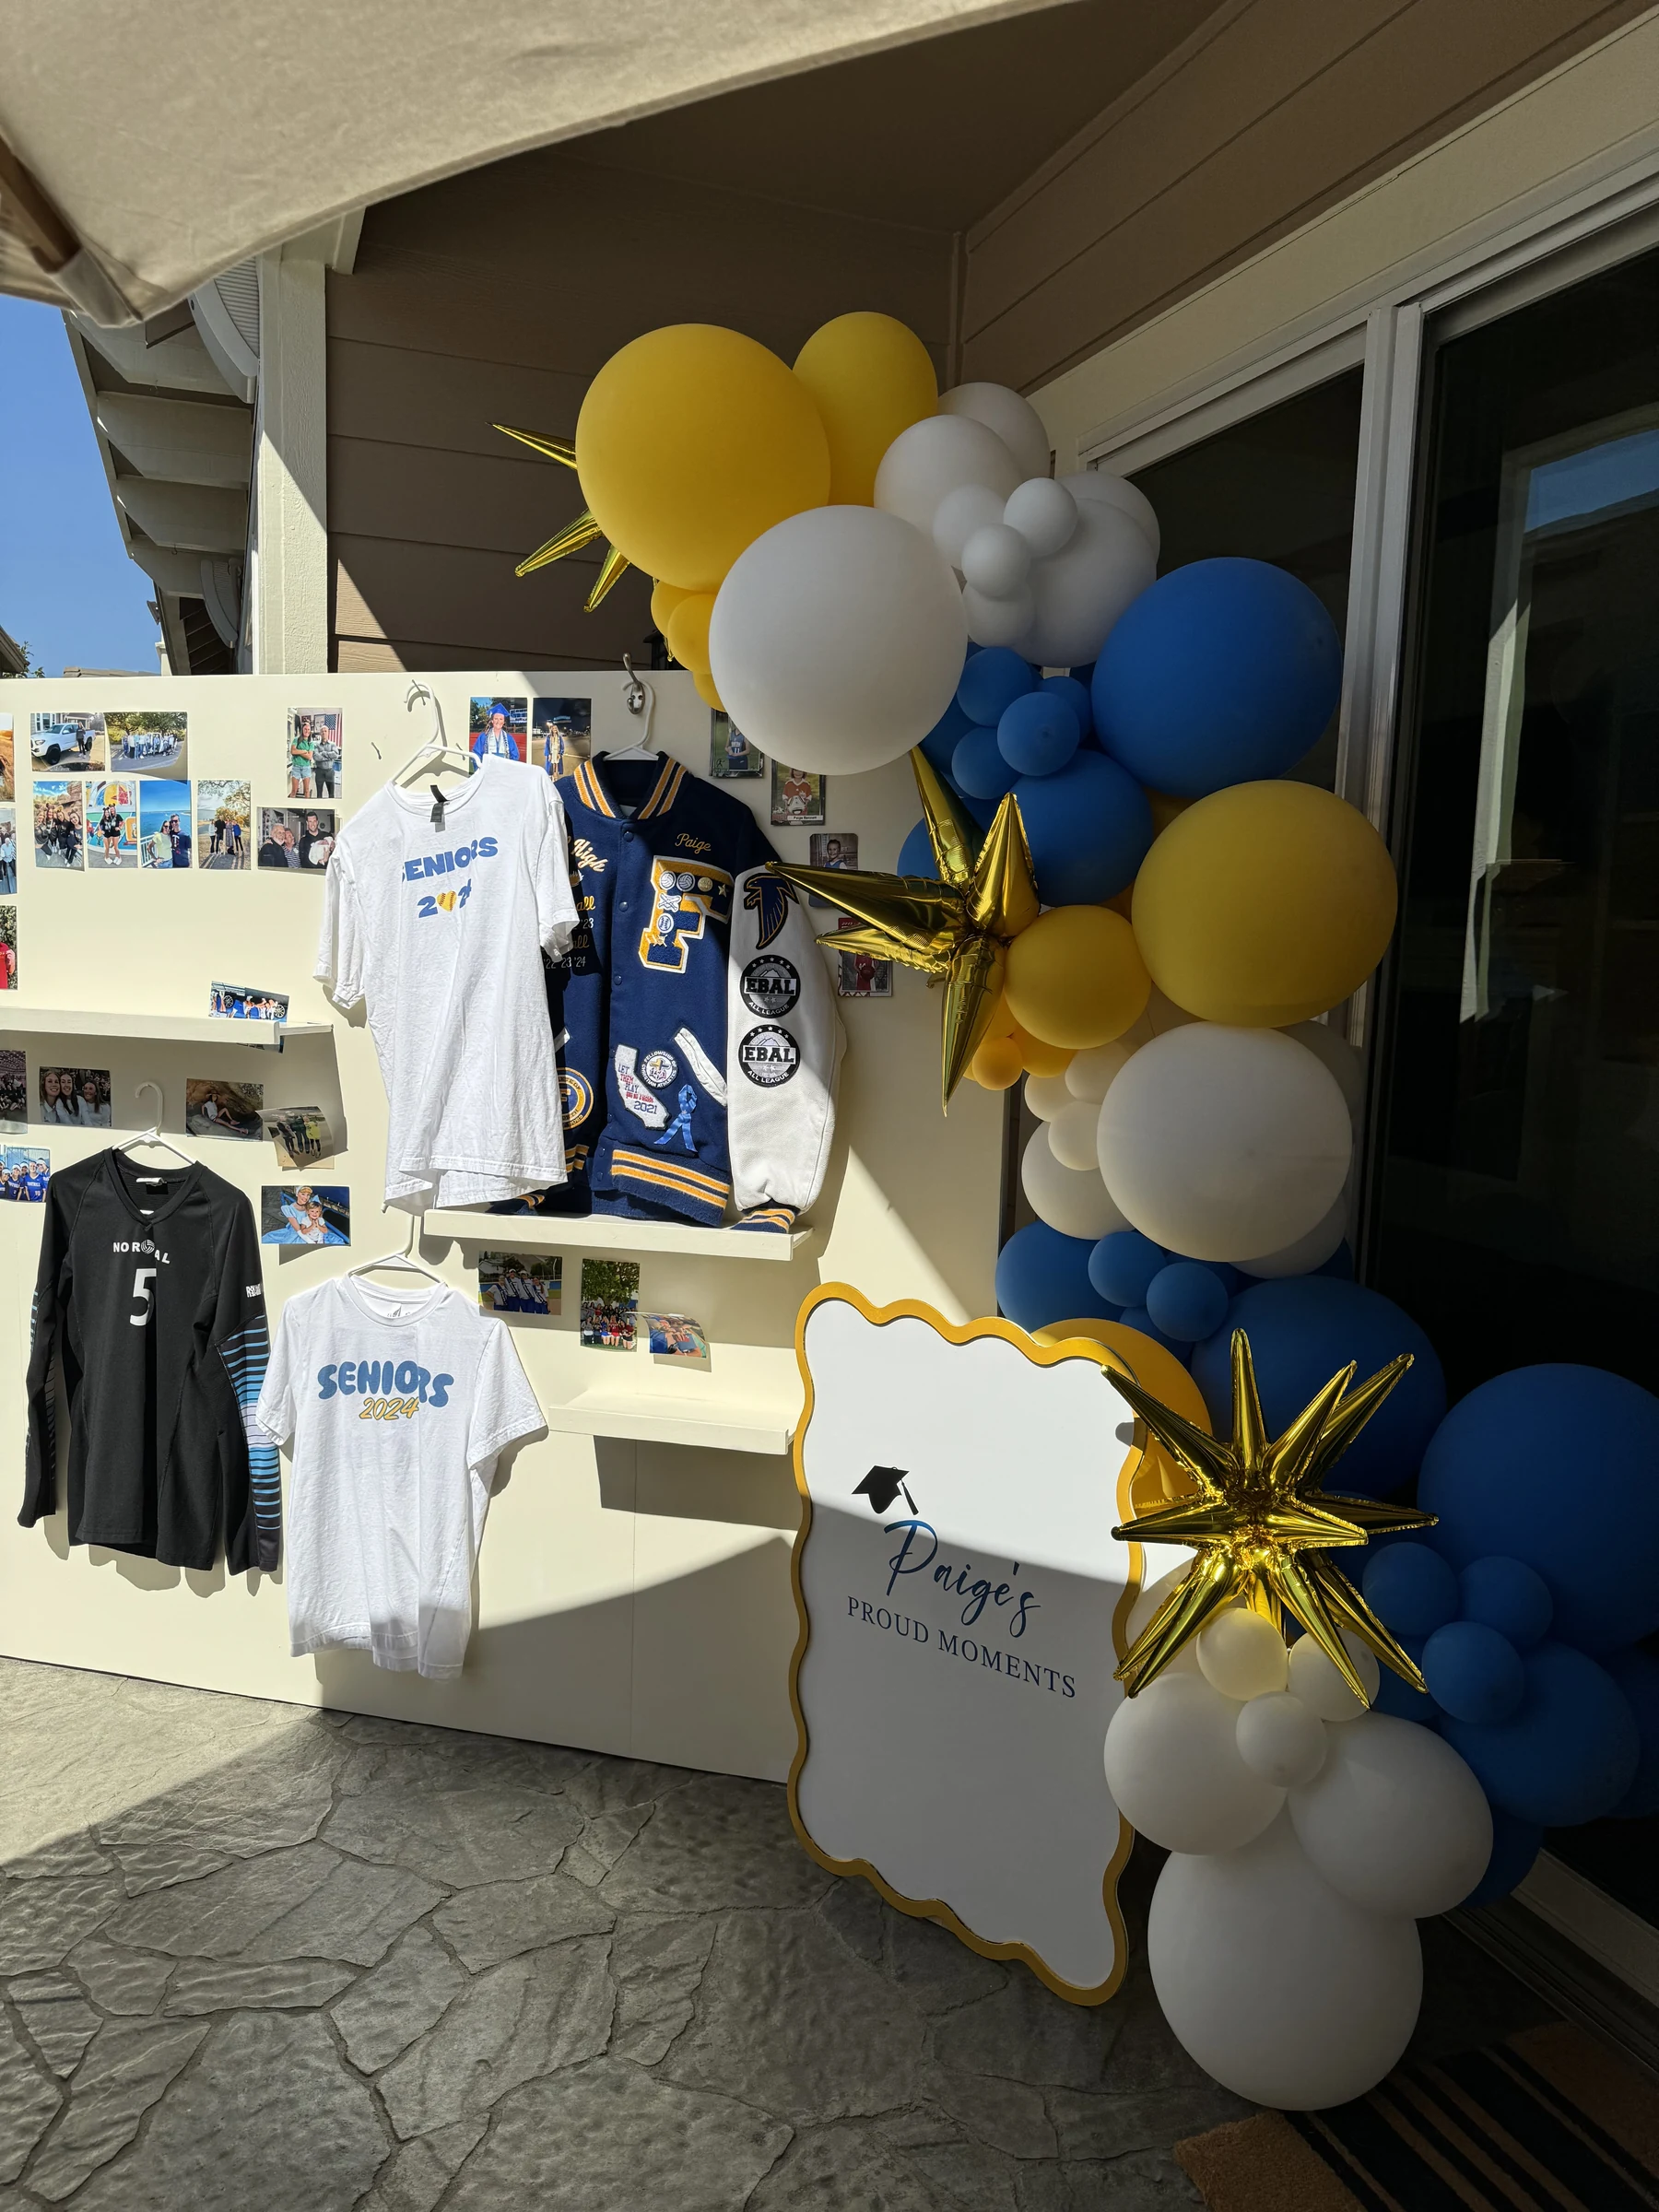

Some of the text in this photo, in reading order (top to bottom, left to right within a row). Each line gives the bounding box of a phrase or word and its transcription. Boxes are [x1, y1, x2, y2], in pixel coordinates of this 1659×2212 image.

[675, 832, 712, 854] Paige
[571, 838, 608, 873] High
[745, 977, 795, 995] EBAL
[748, 1001, 790, 1015] ALL LEAGUE
[744, 1046, 794, 1064] EBAL
[618, 1064, 630, 1075] LET
[747, 1070, 790, 1084] ALL LEAGUE
[633, 1100, 658, 1115] 2021
[129, 1267, 158, 1326] 5
[317, 1359, 454, 1408] SENIORS
[359, 1396, 420, 1421] 2024
[883, 1519, 1041, 1639] Paige's
[846, 1594, 1077, 1699] PROUD MOMENTS
